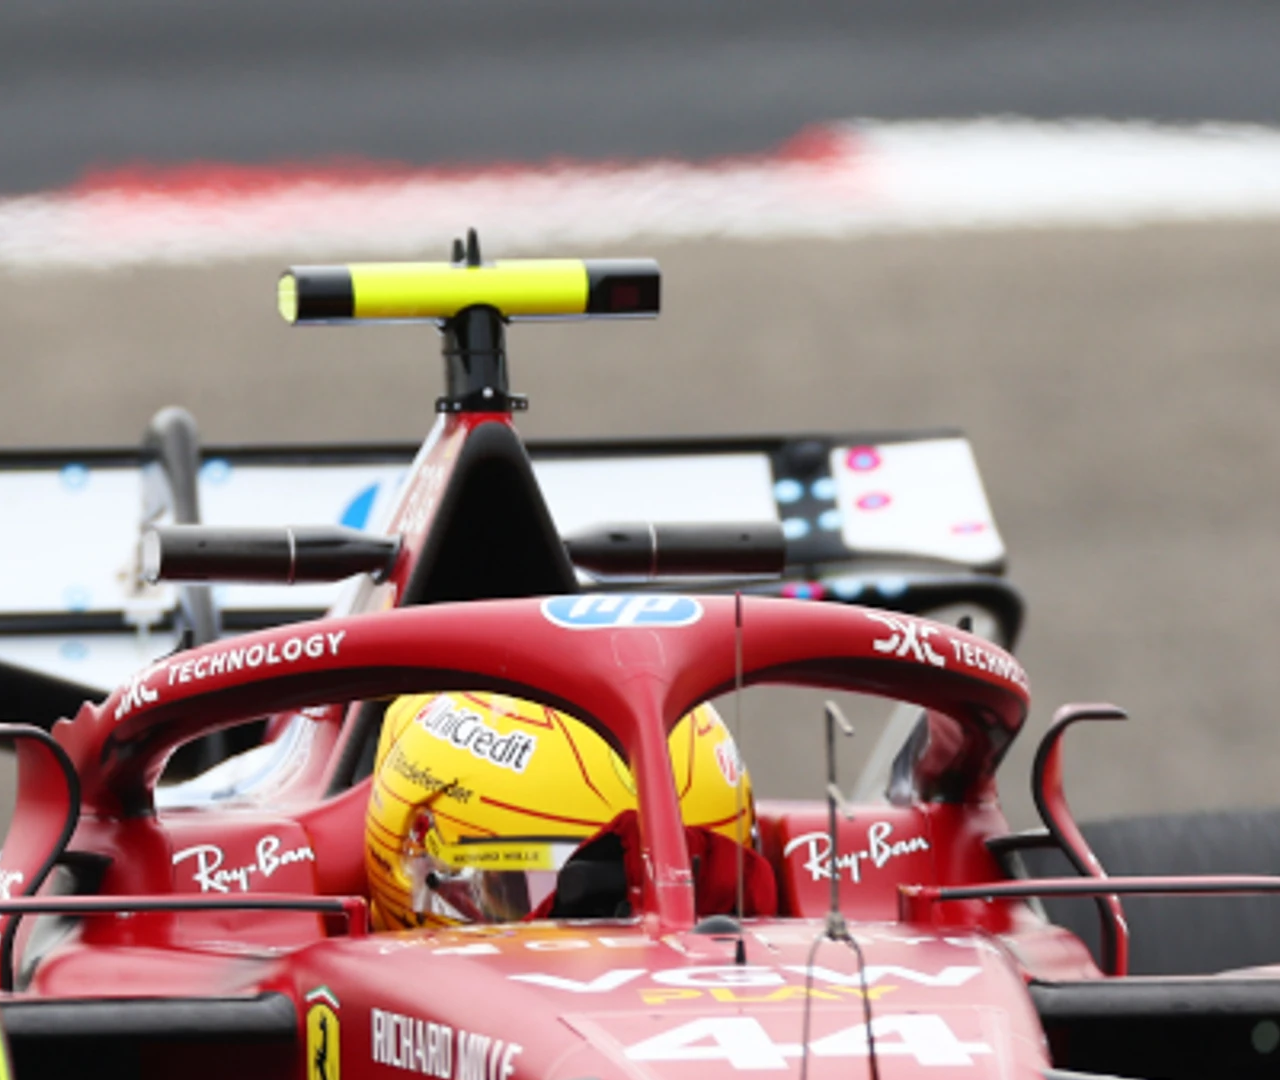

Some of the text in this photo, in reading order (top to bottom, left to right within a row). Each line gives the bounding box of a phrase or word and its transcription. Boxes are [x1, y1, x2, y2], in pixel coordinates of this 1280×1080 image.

[167, 631, 347, 686] TECHNOLOGY
[949, 639, 1029, 688] TECHNO
[424, 698, 534, 770] UniCredit
[172, 835, 316, 894] Ray-Ban
[783, 822, 930, 882] Ray-Ban
[507, 965, 983, 993] VGW
[637, 984, 901, 1004] PLAY
[371, 1007, 454, 1080] RICHARD
[623, 1013, 995, 1071] 44
